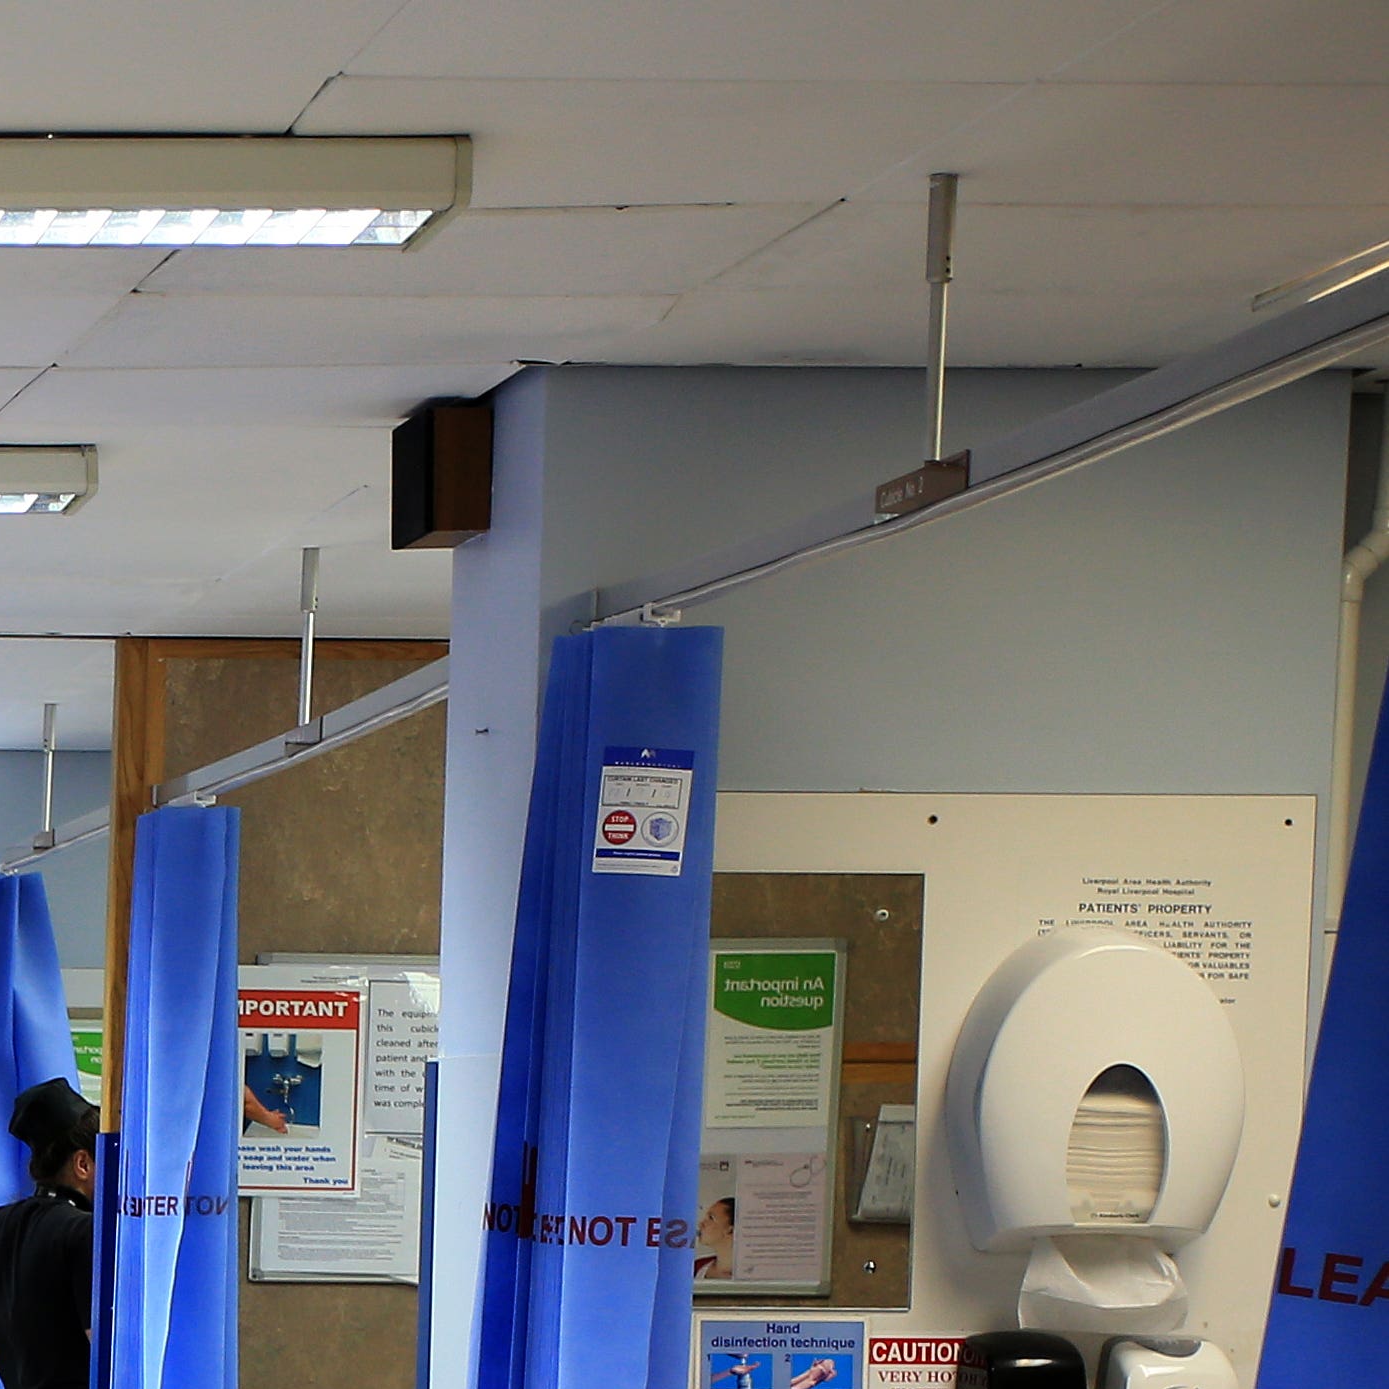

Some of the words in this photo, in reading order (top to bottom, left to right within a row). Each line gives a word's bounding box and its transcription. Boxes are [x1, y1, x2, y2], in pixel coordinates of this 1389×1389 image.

[1176, 879, 1212, 887] Authority
[1097, 887, 1120, 895] Royal
[1148, 903, 1213, 914] PROPERTY
[1238, 931, 1252, 939] OR
[239, 1000, 349, 1017] PORTANT
[377, 1008, 394, 1018] The
[376, 1024, 394, 1032] this
[375, 1039, 411, 1048] cleaned
[417, 1039, 438, 1048] after
[375, 1055, 408, 1063] patient
[410, 1054, 428, 1062] and
[375, 1069, 395, 1077] with
[401, 1069, 417, 1078] the
[374, 1084, 395, 1092] time
[400, 1084, 411, 1092] of
[373, 1099, 391, 1107] was
[283, 1146, 303, 1154] your
[243, 1154, 264, 1162] soap
[243, 1163, 274, 1172] leaving
[276, 1163, 292, 1171] this
[303, 1176, 330, 1185] Thank
[332, 1178, 348, 1186] you
[568, 1215, 637, 1247] NOT
[766, 1323, 801, 1334] Hand
[711, 1337, 787, 1348] disinfection
[790, 1337, 856, 1350] technique
[785, 1353, 791, 1362] 2
[878, 1370, 922, 1383] VERY
